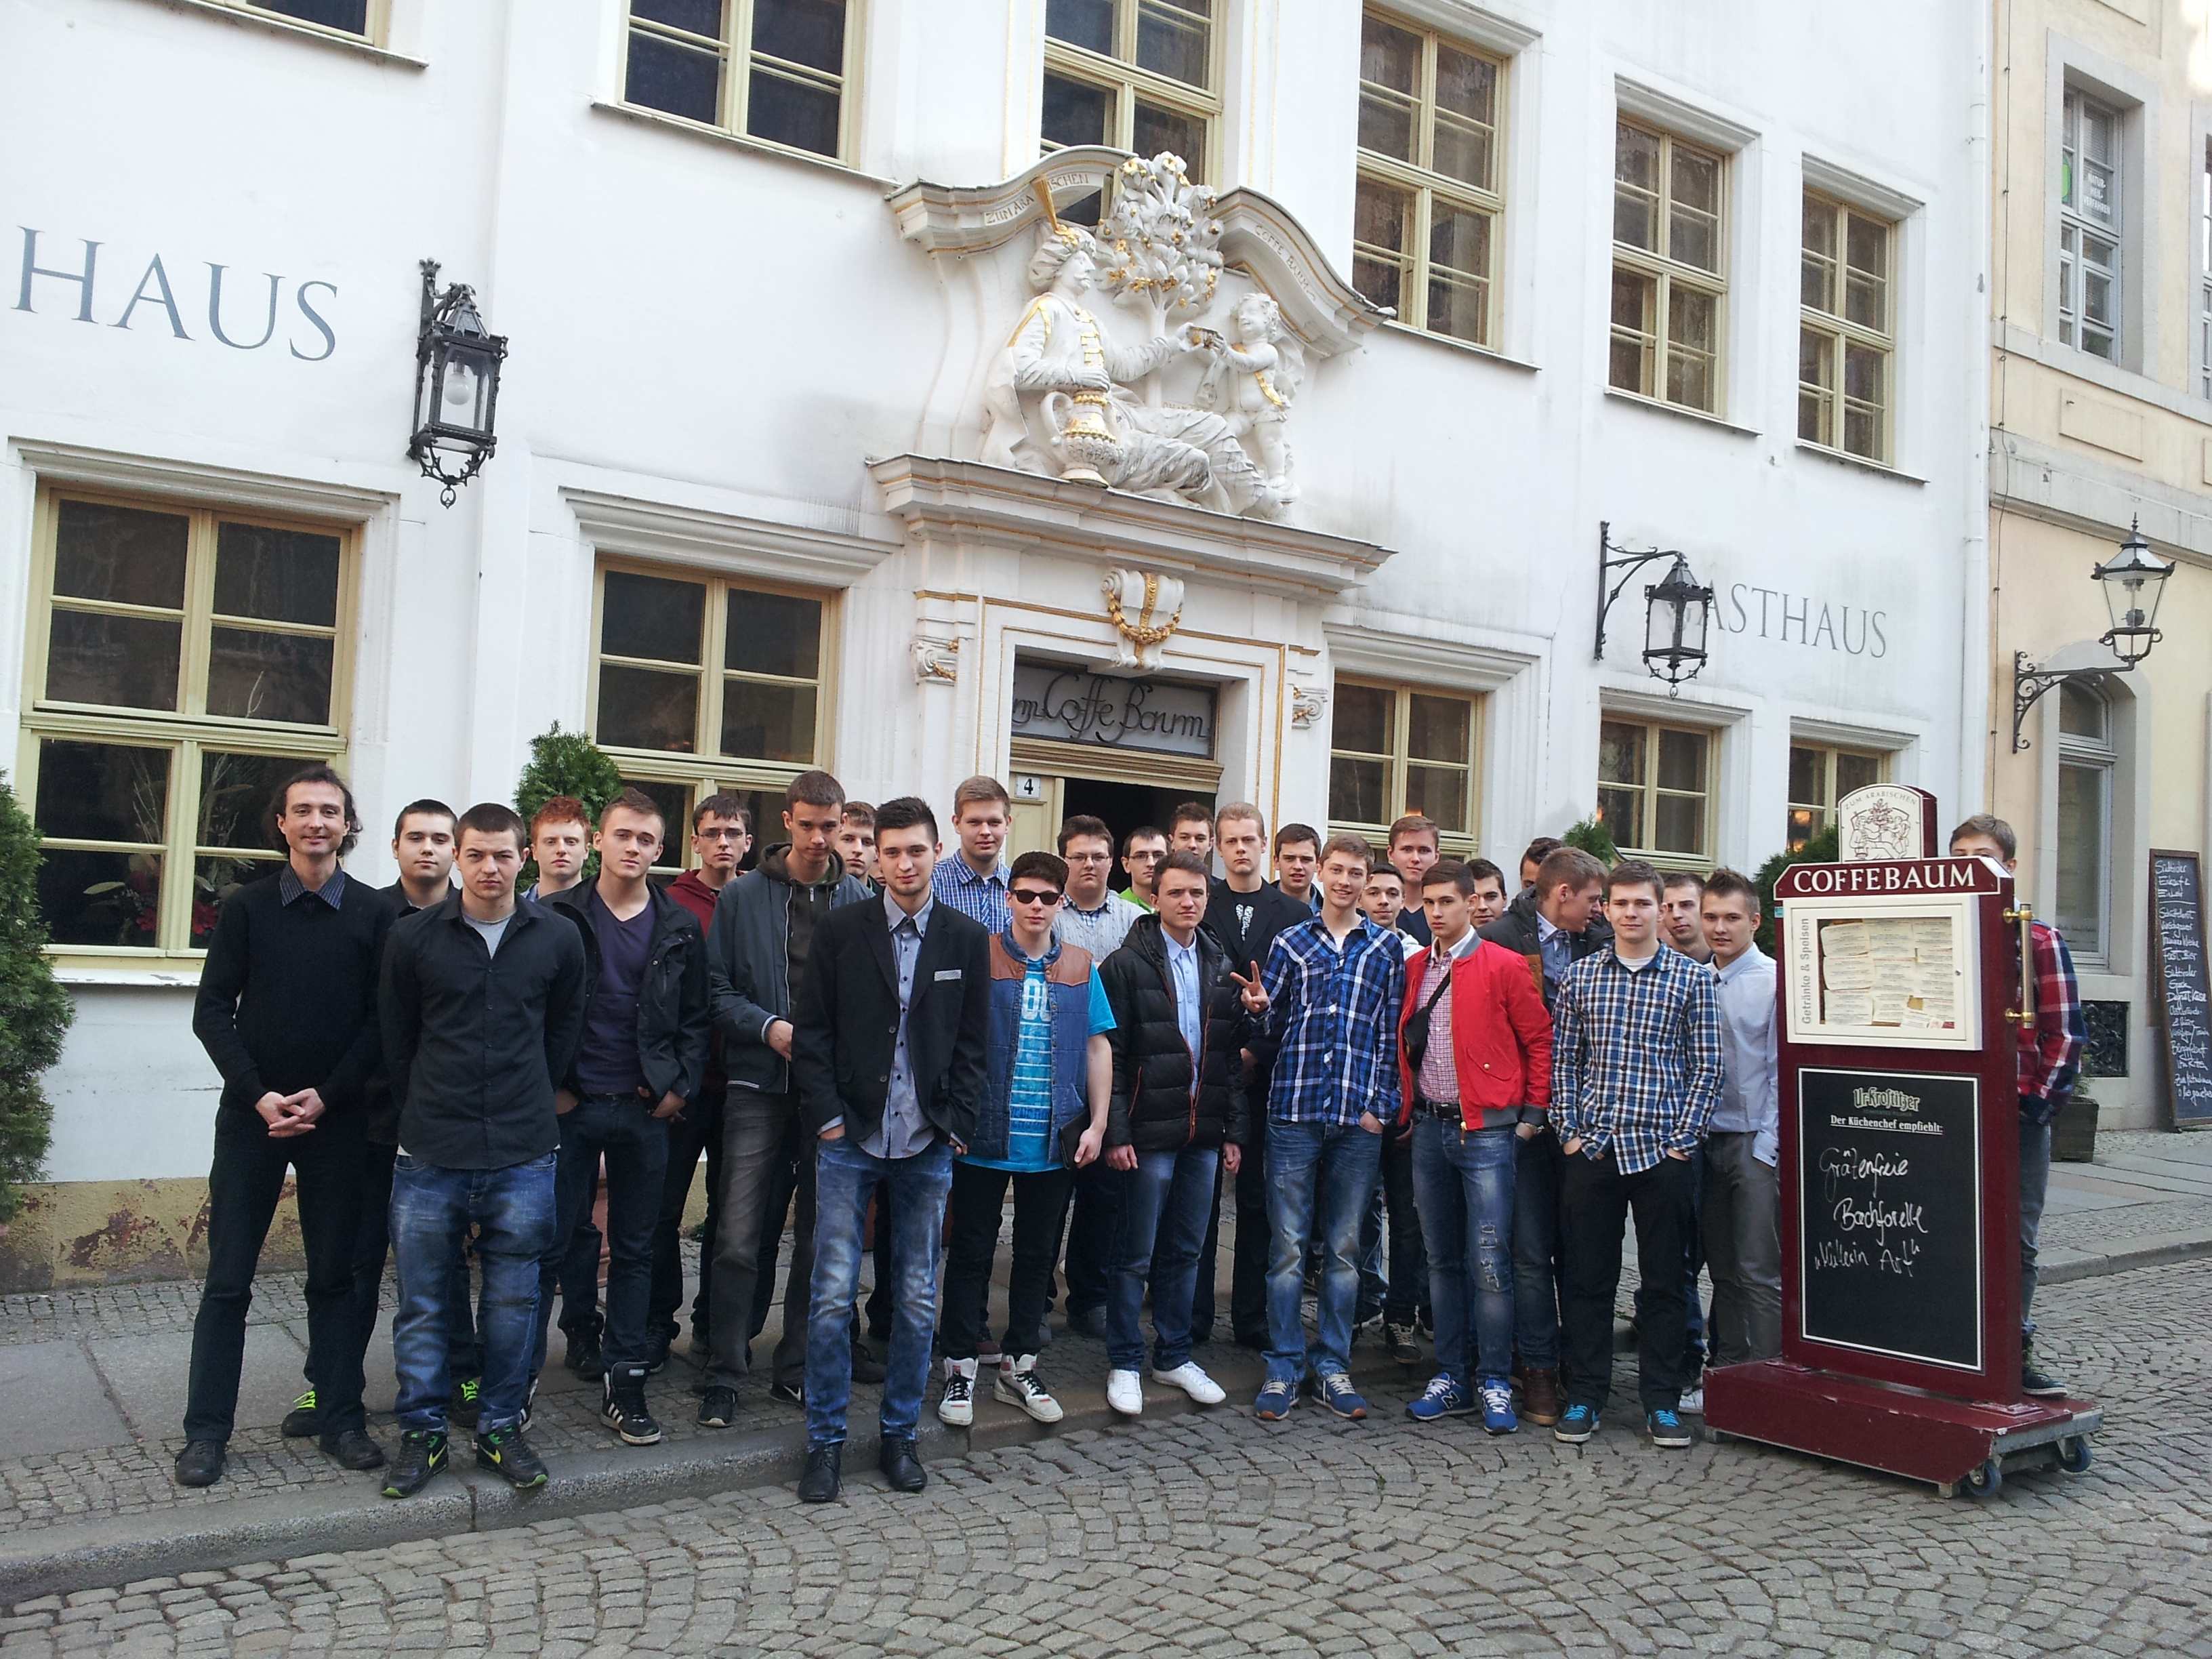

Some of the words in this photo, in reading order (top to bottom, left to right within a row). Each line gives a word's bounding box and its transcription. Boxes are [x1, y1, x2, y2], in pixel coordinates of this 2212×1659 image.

[10, 225, 339, 362] HAUS
[1095, 682, 1207, 743] Baum
[1023, 778, 1034, 795] 4
[1844, 797, 1862, 811] ZUM
[1865, 790, 1917, 805] ARABISCHEN
[1793, 863, 1976, 893] COFFEBAUM
[1800, 918, 1811, 960] Speisen
[1801, 975, 1811, 1024] Getränke
[1830, 1114, 1846, 1125] Der
[1848, 1116, 1898, 1129] Küchenchef
[1899, 1120, 1944, 1134] empfiehlt:
[1833, 1197, 1929, 1246] Bachforelle
